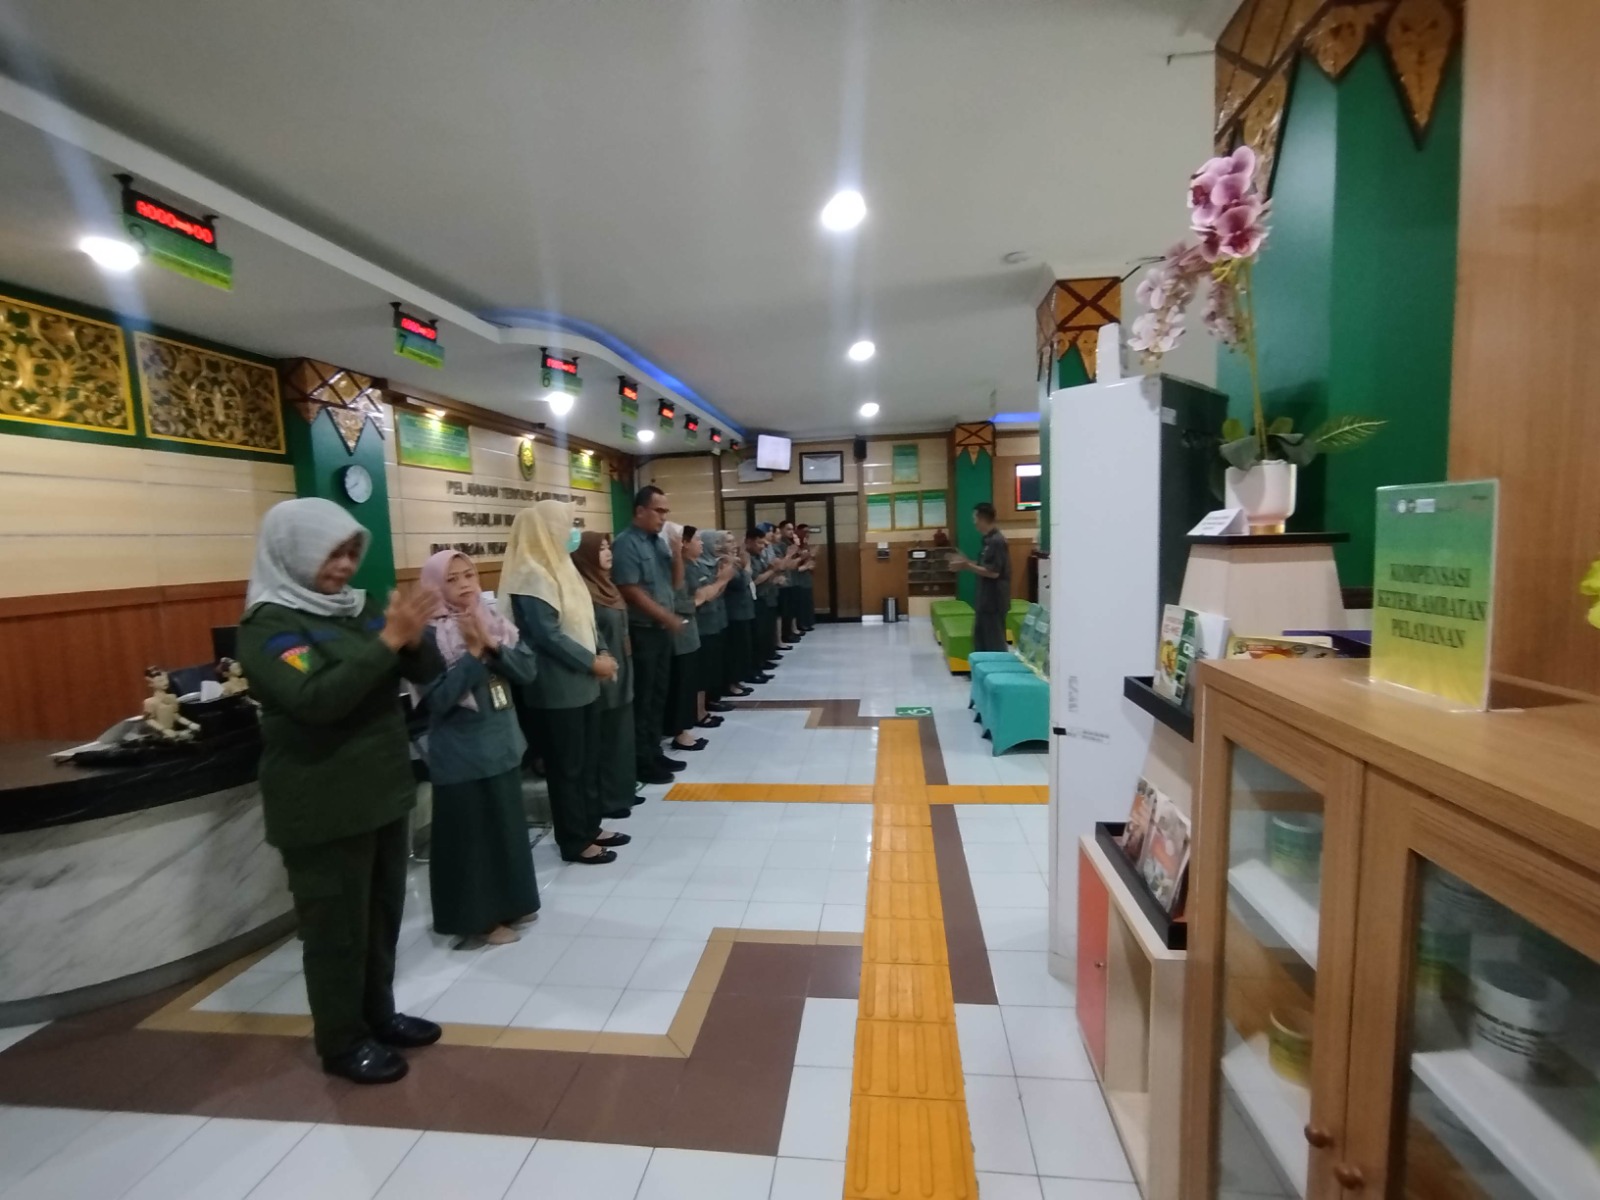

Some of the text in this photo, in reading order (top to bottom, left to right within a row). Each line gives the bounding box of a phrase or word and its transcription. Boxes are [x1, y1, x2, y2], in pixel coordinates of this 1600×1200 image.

[543, 371, 551, 388] 6
[446, 480, 499, 498] PELAYANAN
[1390, 564, 1472, 588] KOMPENSASI
[1378, 590, 1488, 621] KETERLAMBATAN
[1391, 619, 1466, 648] PELAYANAN
